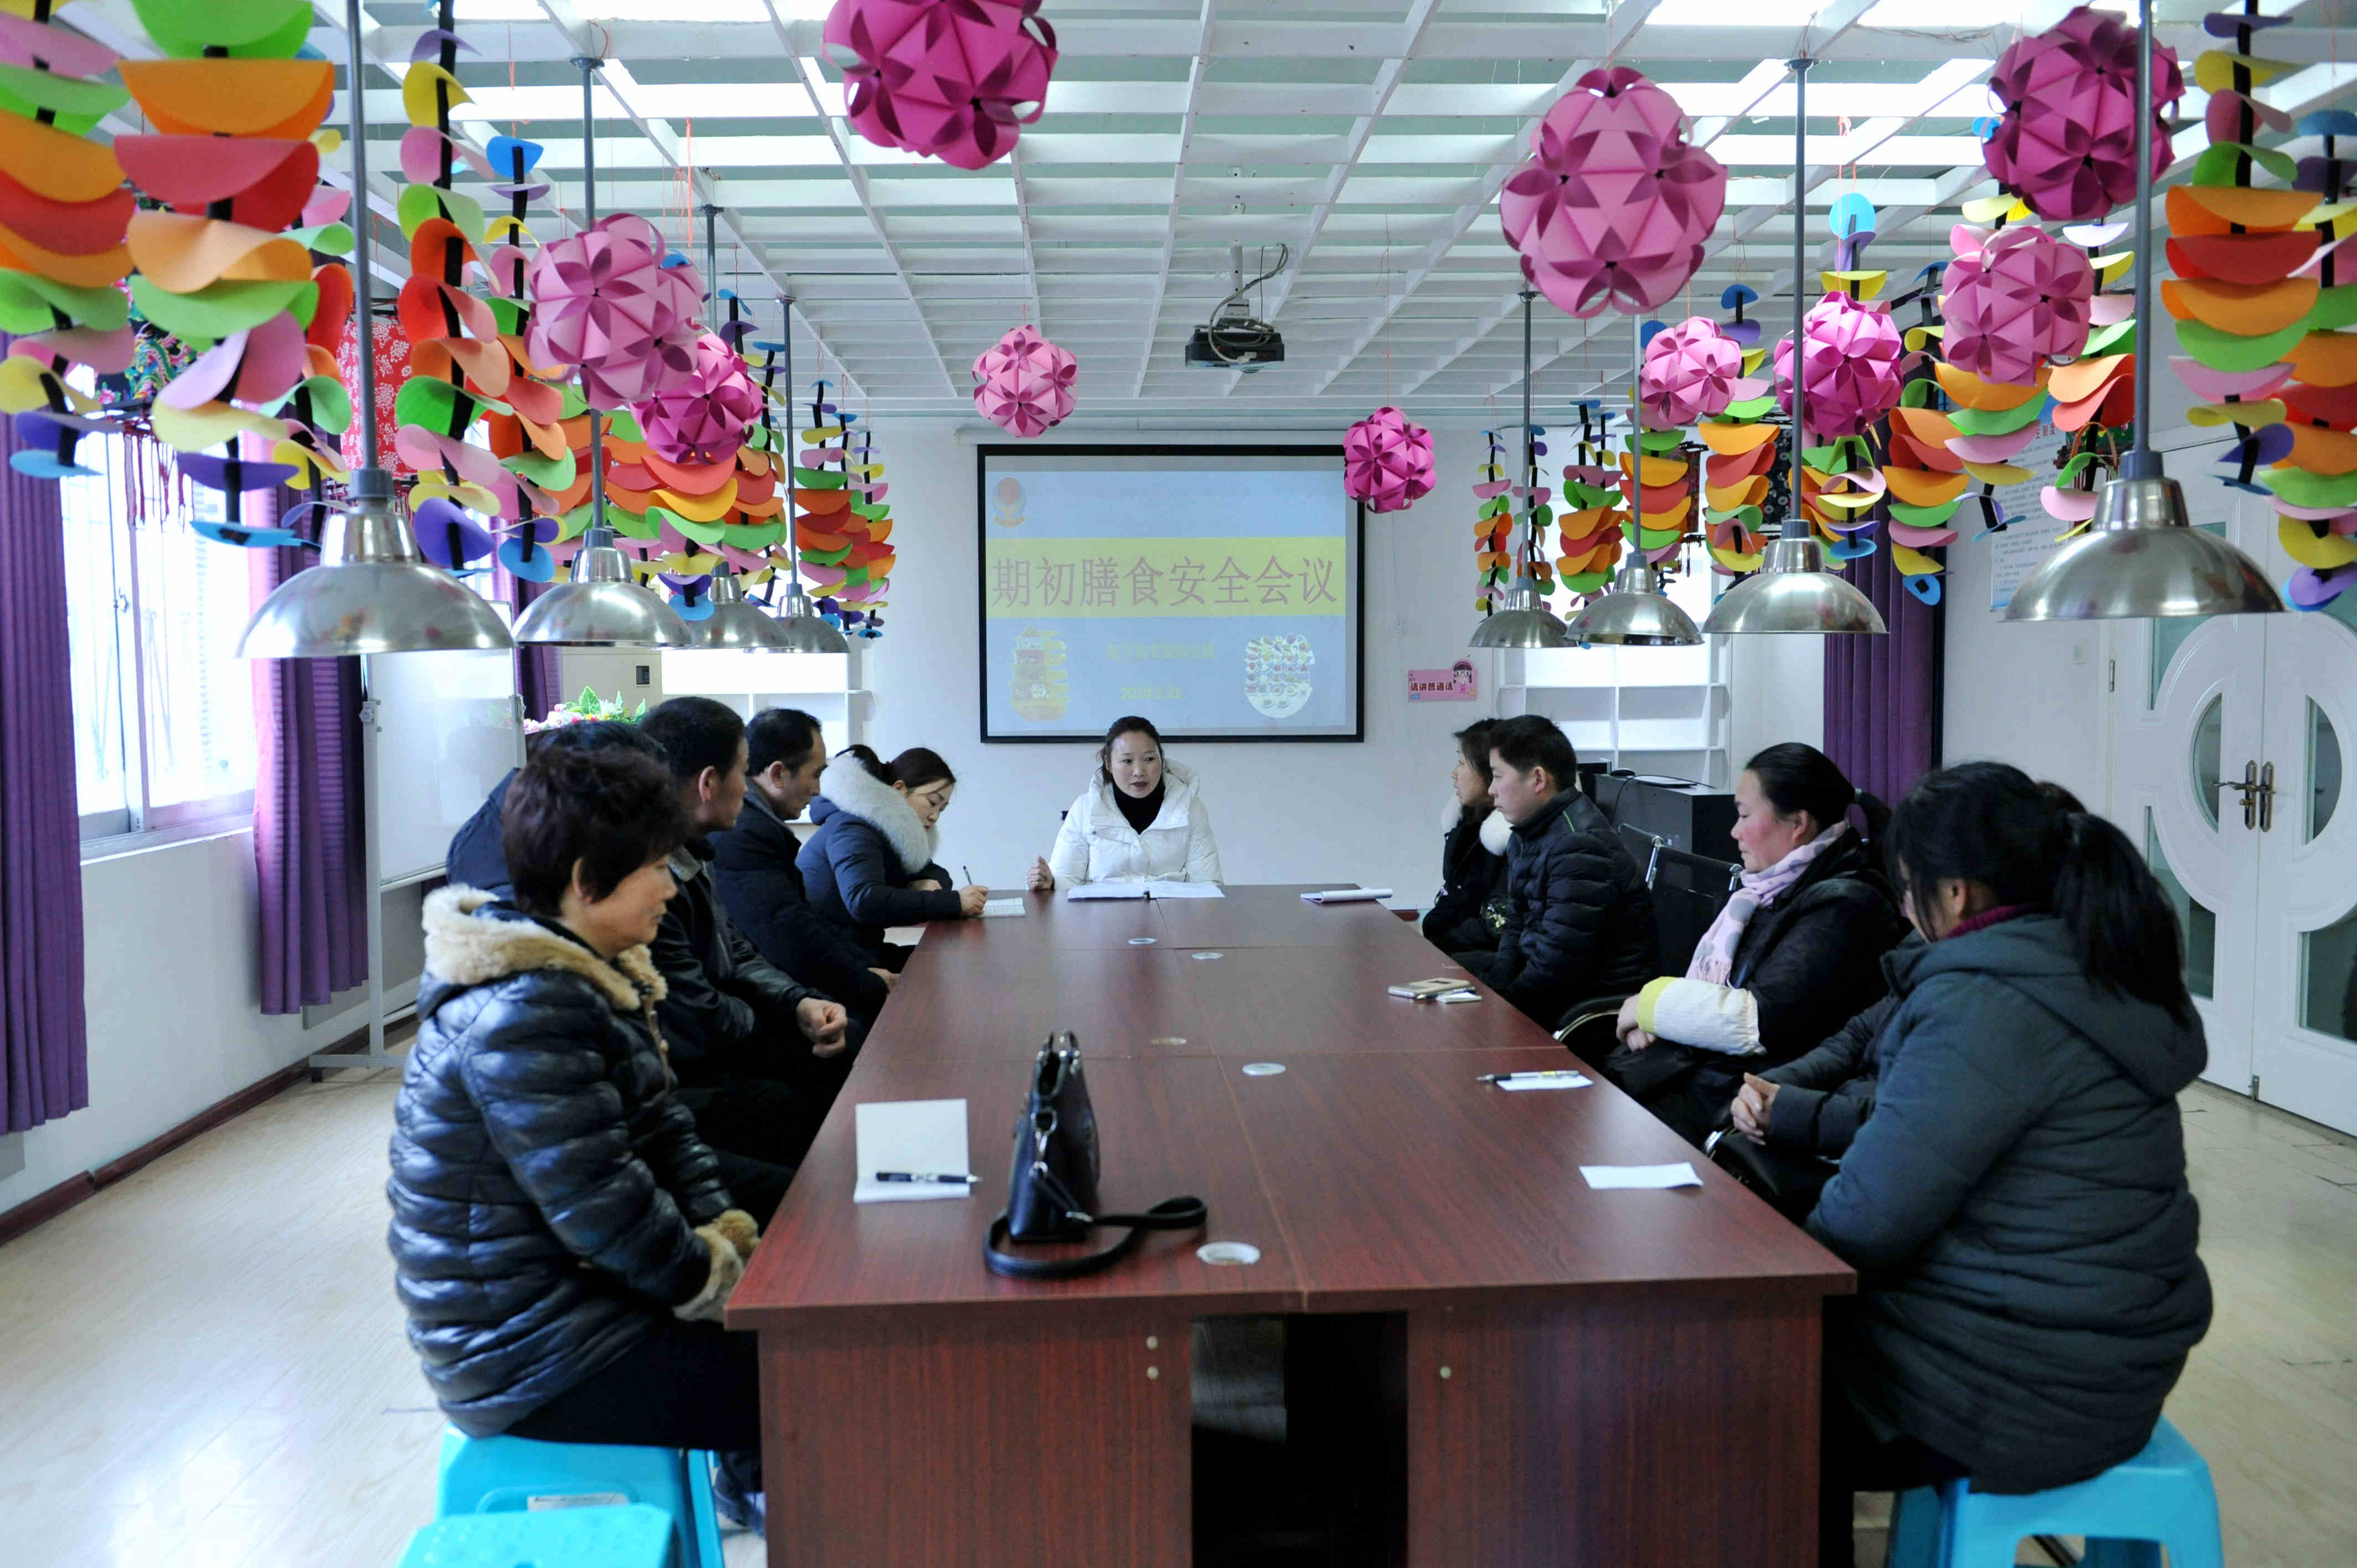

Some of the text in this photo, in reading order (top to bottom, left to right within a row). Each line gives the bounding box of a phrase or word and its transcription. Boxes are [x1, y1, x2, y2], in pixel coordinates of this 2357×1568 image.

[992, 555, 1337, 607] 期初膳食安全会议
[1411, 682, 1453, 692] 请讲普通话
